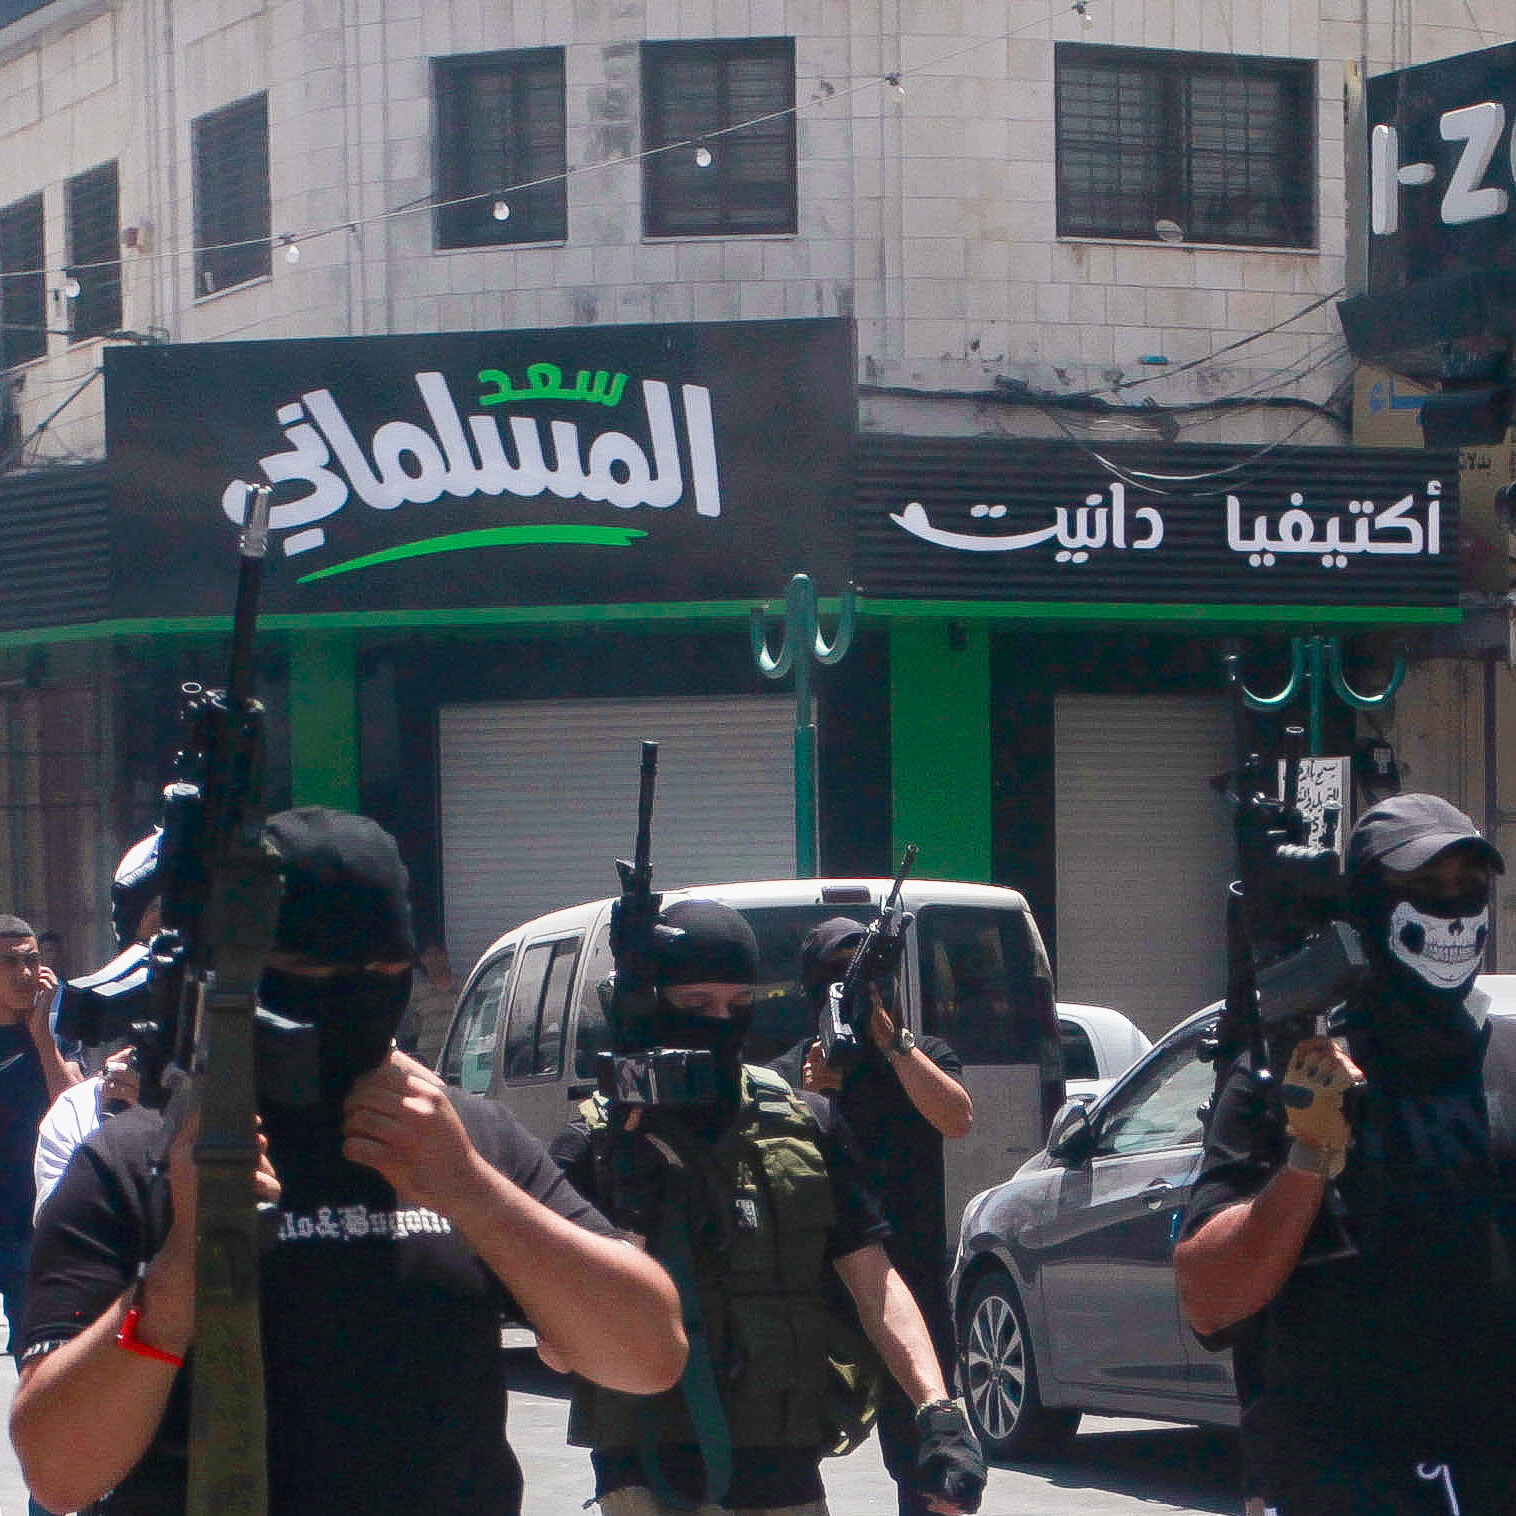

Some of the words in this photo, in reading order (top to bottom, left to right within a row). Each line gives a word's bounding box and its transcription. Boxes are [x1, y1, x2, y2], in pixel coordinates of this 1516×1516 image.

[479, 363, 628, 406] سعد
[221, 371, 721, 557] المسلماني
[889, 482, 1165, 564] دانيت
[1226, 480, 1442, 568] أكتيفيا
